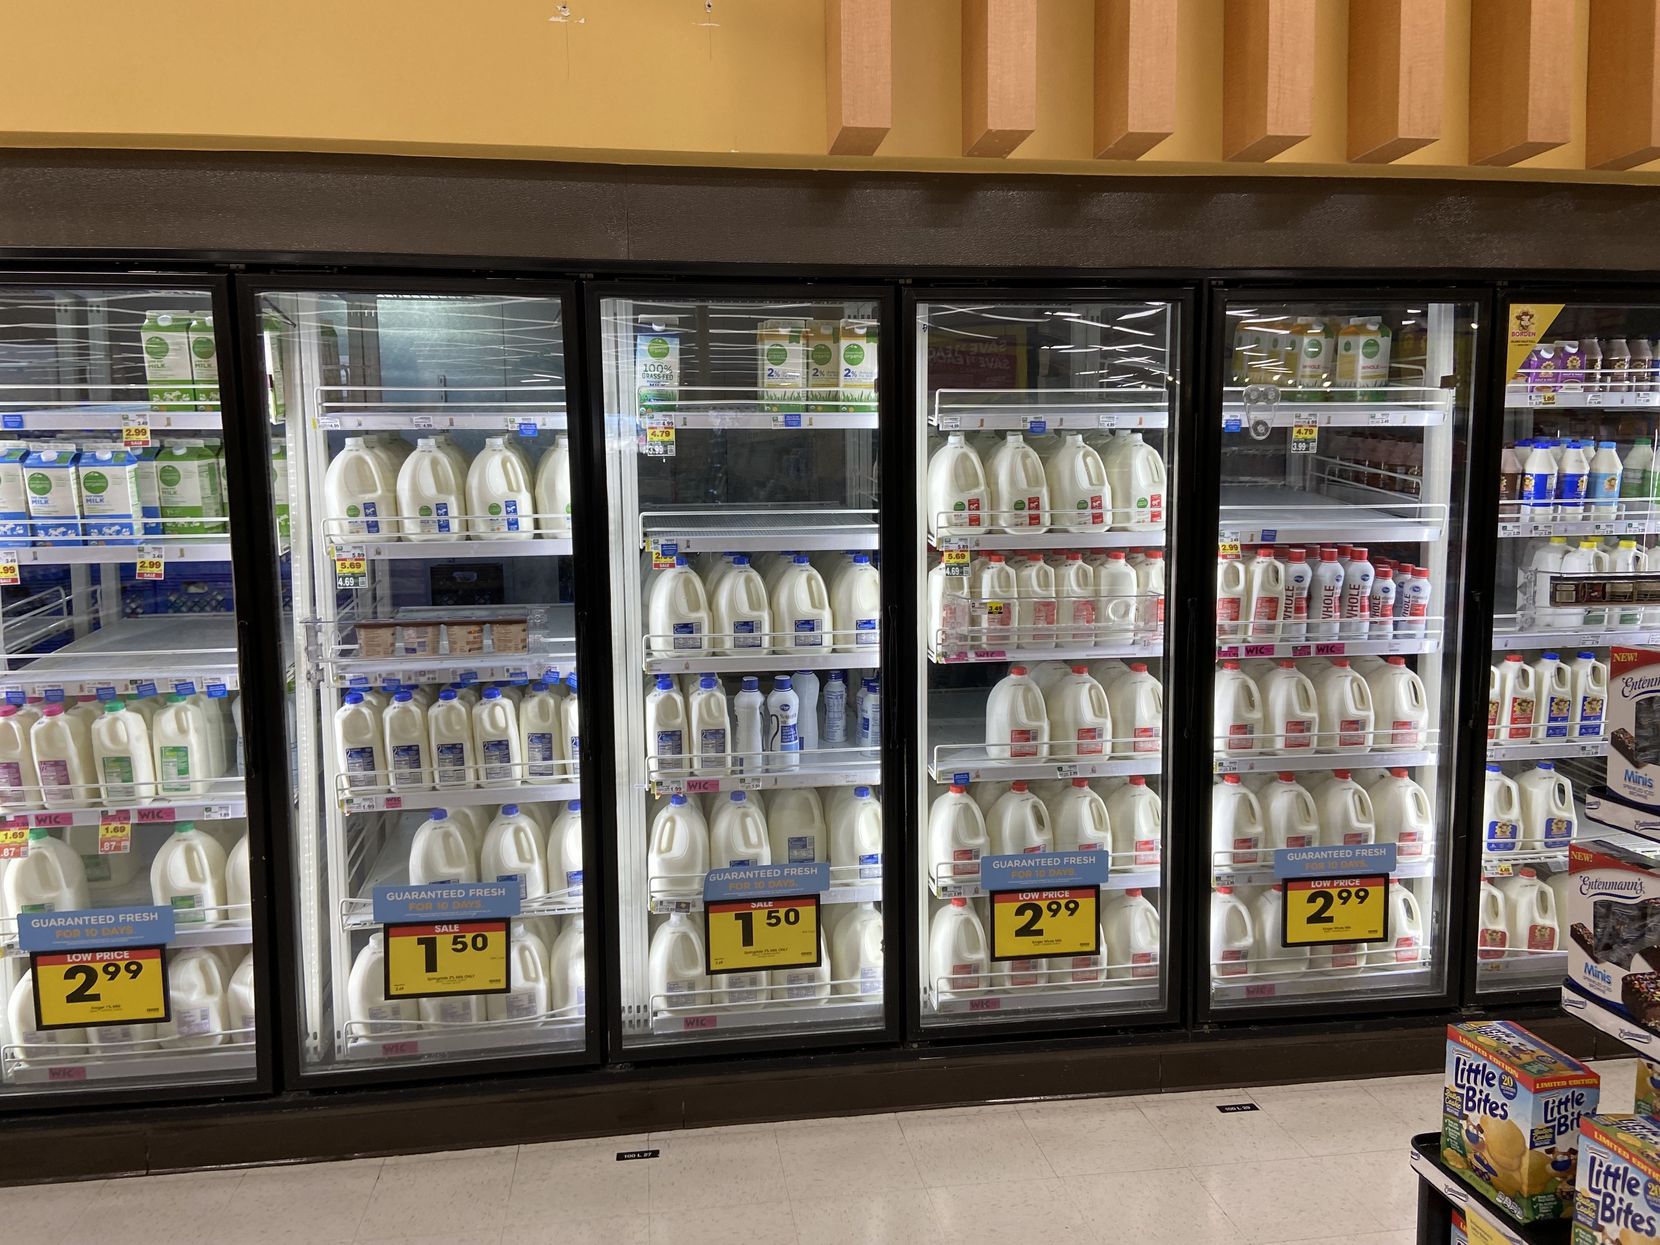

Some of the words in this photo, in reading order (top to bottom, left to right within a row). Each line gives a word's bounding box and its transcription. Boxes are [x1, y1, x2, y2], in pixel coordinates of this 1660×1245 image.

[643, 364, 673, 374] 100%
[767, 368, 781, 378] 2%
[812, 368, 825, 378] 2%
[843, 368, 858, 378] 2%
[125, 428, 147, 437] 2.99
[1292, 442, 1306, 451] 3.99
[139, 560, 161, 569] 2.99
[946, 567, 960, 576] 4.69
[338, 577, 354, 586] 4.69
[1245, 646, 1265, 655] WIC
[1315, 644, 1336, 653] WIC
[1613, 652, 1638, 662] NEW!
[1624, 769, 1654, 788] Minis
[687, 782, 709, 790] WIC
[35, 815, 61, 825] WIC
[138, 810, 164, 820] WIC
[104, 825, 126, 834] 1.69
[2, 831, 25, 840] 1.69
[100, 841, 116, 851] .87
[1287, 850, 1353, 861] GUARANTEED
[1355, 848, 1387, 857] FRESH
[1570, 851, 1593, 863] NEW!
[992, 858, 1061, 869] GUARANTEED
[1063, 856, 1096, 865] FRESH
[1305, 863, 1326, 871] FOR
[709, 869, 781, 882] GUARANTEED
[784, 867, 818, 876] FRESH
[728, 882, 751, 891] FOR
[1311, 880, 1331, 888] LOW
[1334, 878, 1360, 887] PRICE
[1579, 875, 1645, 896] Entenmann's
[386, 889, 465, 901] GUARANTEED
[469, 888, 506, 897] FRESH
[1018, 892, 1040, 900] LOW
[1042, 890, 1070, 899] PRICE
[408, 902, 433, 911] FOR
[31, 915, 115, 929] GUARANTEED
[118, 912, 159, 923] FRESH
[434, 924, 460, 933] SALE
[55, 929, 81, 939] FOR
[66, 952, 92, 963] LOW
[95, 950, 130, 961] PRICE
[1584, 962, 1612, 984] Minis
[685, 1019, 706, 1027] WIC
[382, 1043, 406, 1053] WIC
[1458, 1035, 1488, 1060] LIMITED
[1488, 1055, 1519, 1079] EDITION
[1454, 1056, 1497, 1090] Little
[1501, 1075, 1514, 1087] 20
[1536, 1080, 1567, 1089] LIMITED
[1464, 1085, 1509, 1121] Bites
[1543, 1089, 1585, 1124] Little
[1593, 1130, 1630, 1160] LIMITED
[1588, 1155, 1641, 1197] Little
[1600, 1191, 1657, 1238] Bites
